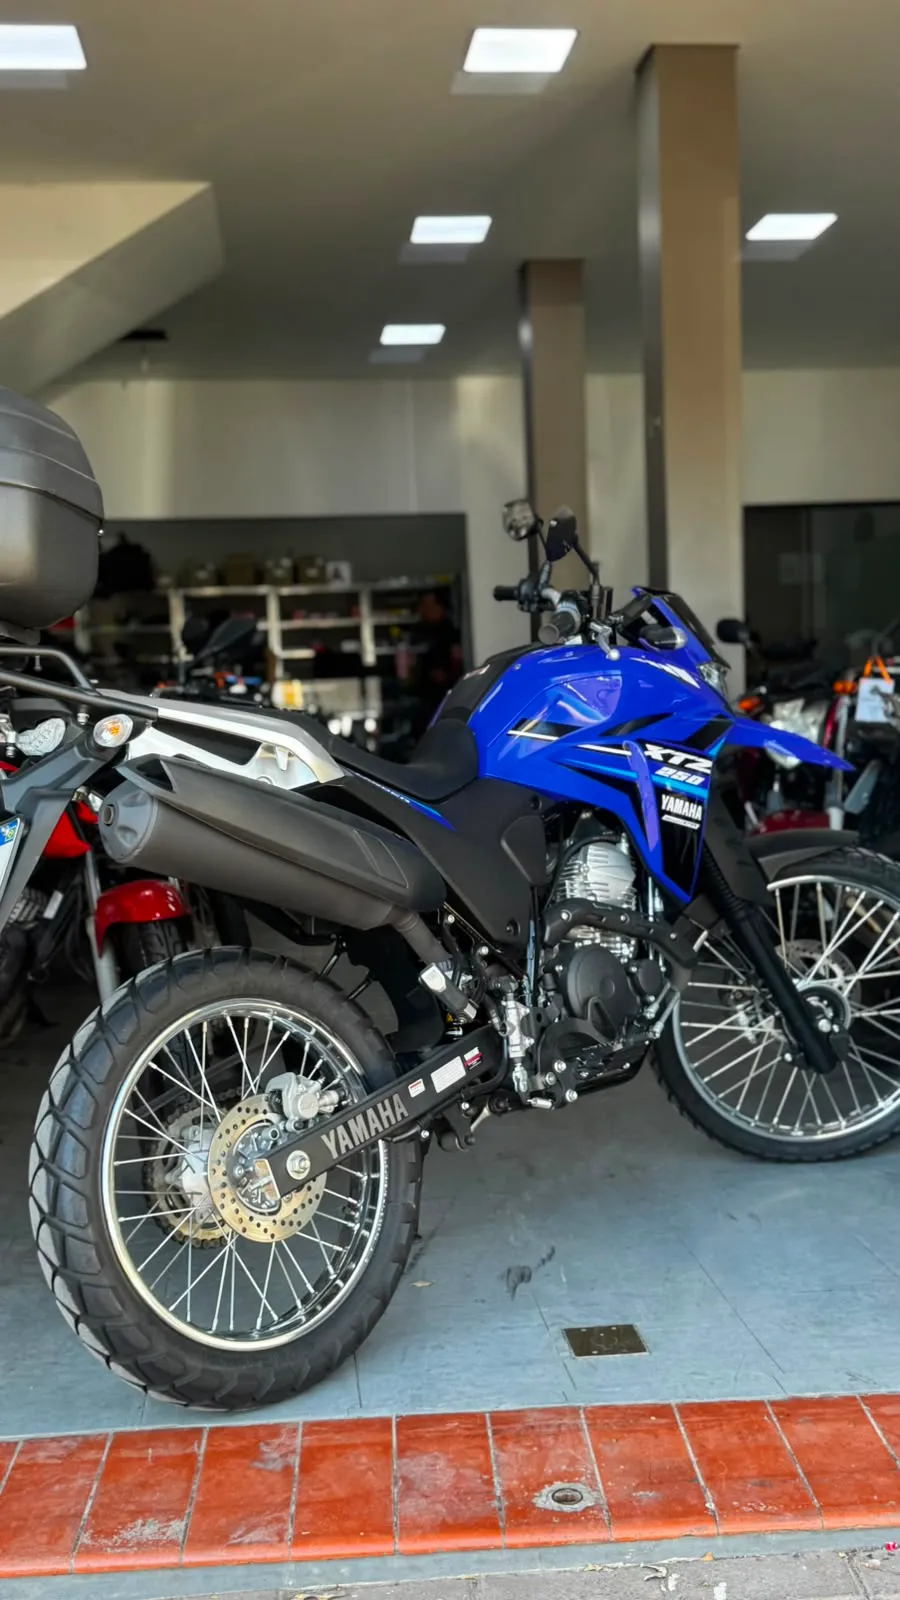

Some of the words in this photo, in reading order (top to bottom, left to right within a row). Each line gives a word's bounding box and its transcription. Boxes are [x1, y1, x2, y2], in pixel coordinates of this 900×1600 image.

[644, 743, 712, 774] XTZ
[655, 766, 705, 785] 250
[661, 794, 702, 821] YAMAHA
[321, 1093, 409, 1159] YAMAHA
